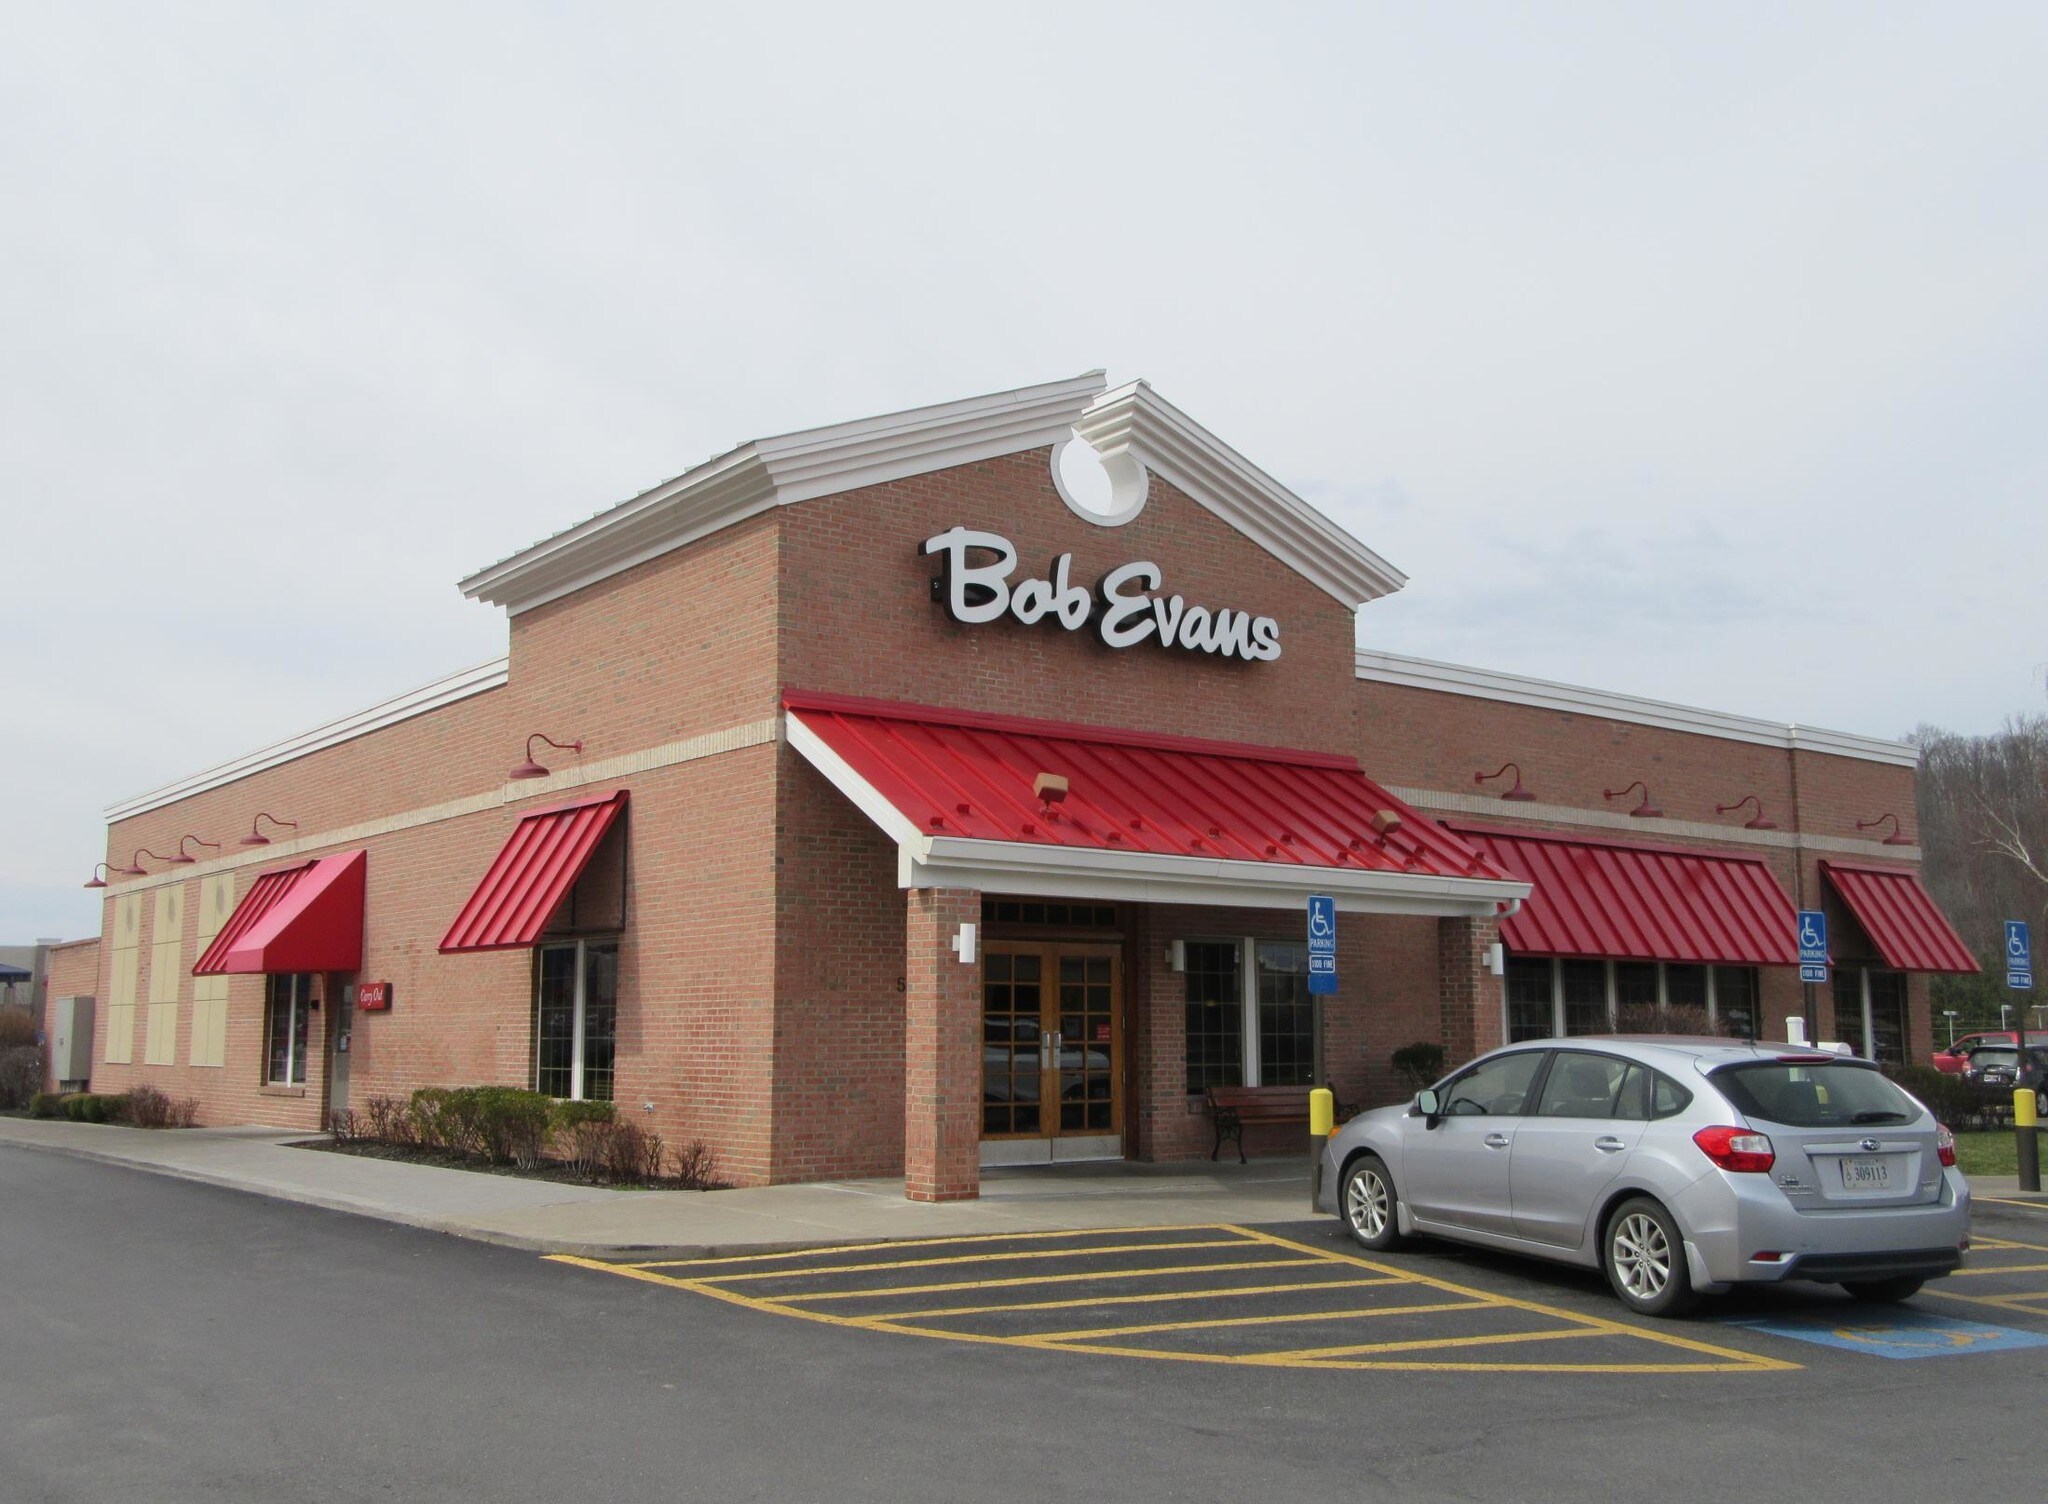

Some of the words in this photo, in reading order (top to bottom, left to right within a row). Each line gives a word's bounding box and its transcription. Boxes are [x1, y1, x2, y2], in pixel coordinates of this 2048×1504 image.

[924, 525, 1092, 631] Bob
[1100, 561, 1282, 661] Evans
[1310, 938, 1333, 949] PARKING
[1800, 949, 1825, 958] PARKING
[360, 988, 373, 1006] Carry
[373, 987, 383, 1001] Out
[1854, 1166, 1888, 1182] 309113
